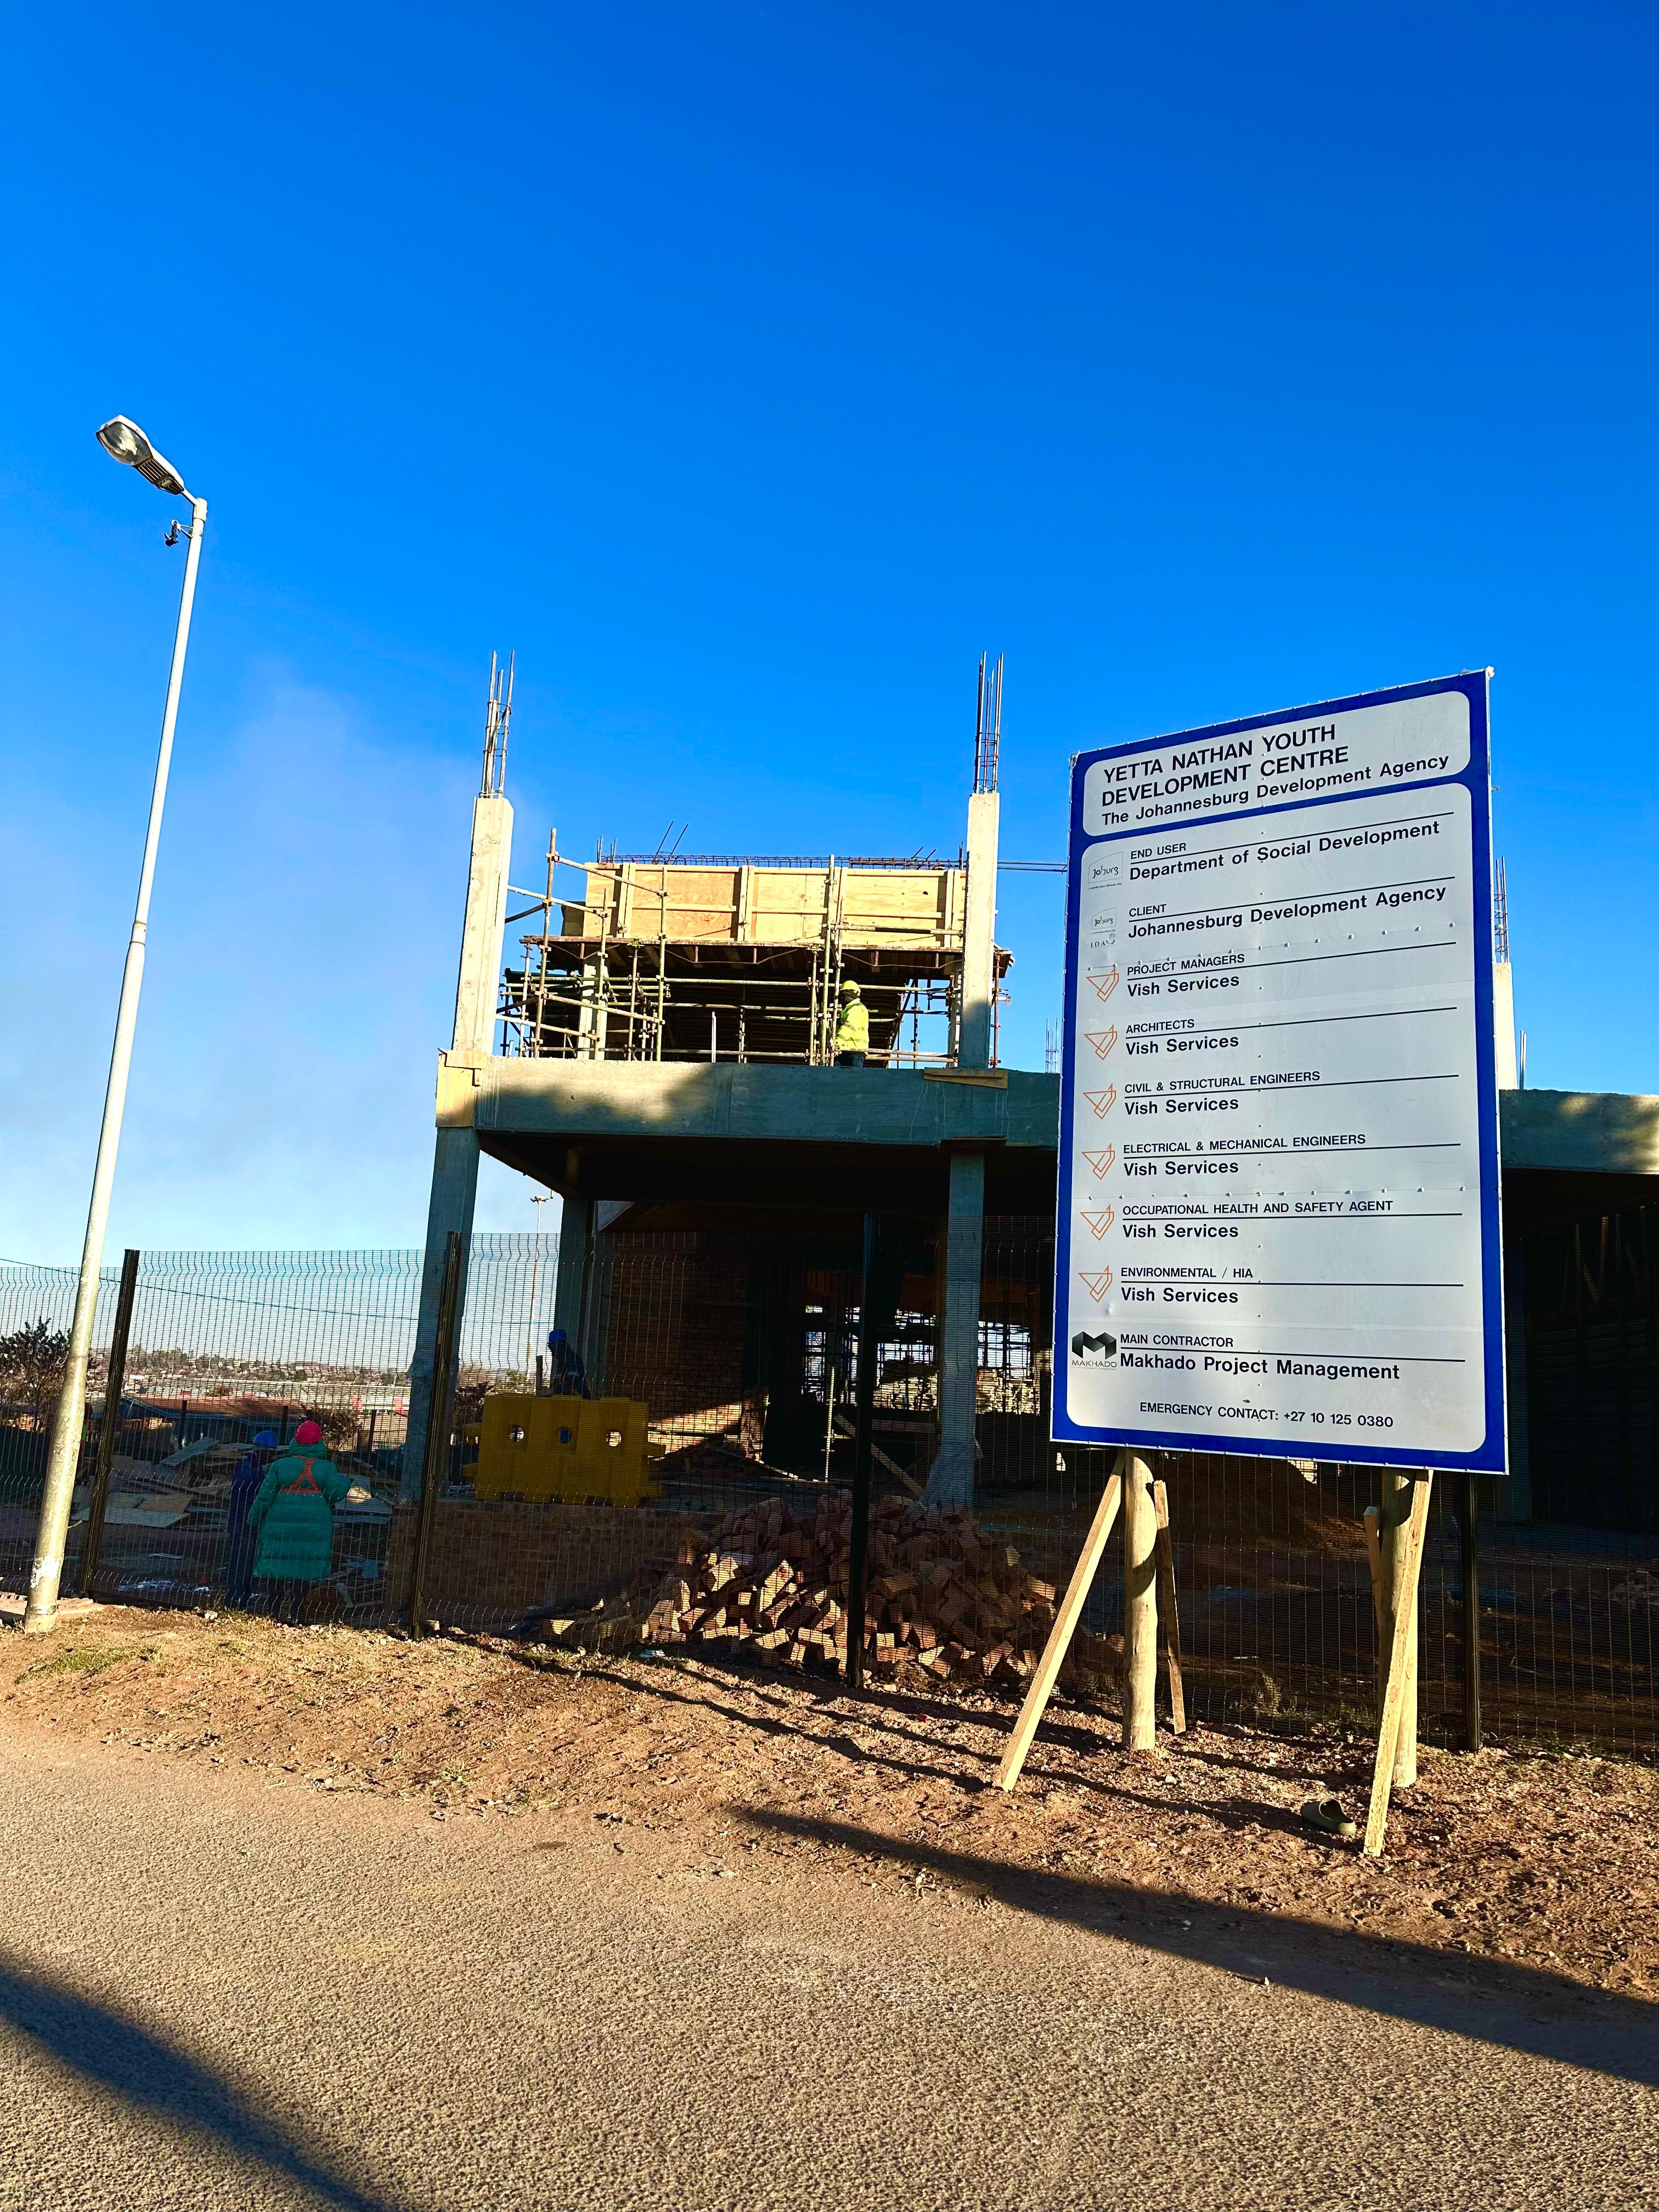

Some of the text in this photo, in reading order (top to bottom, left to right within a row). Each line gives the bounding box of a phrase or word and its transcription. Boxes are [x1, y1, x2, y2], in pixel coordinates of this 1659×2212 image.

[1103, 724, 1336, 783] YETTA NATHAN YOUTH
[1102, 746, 1349, 806] DEVELOPMENT CENTRE
[1102, 755, 1449, 826] The Johannesburg Development Agency
[1130, 842, 1187, 860] END USER
[1130, 821, 1440, 881] Department of Social Development
[1092, 865, 1119, 879] Joburg
[1128, 904, 1167, 917] CLIENT
[1128, 887, 1446, 939] Johannesburg Development Agency
[1127, 953, 1245, 976] PROJECT MANAGERS
[1127, 976, 1239, 997] Vish Services
[1126, 1019, 1195, 1034] ARCHITECTS
[1125, 1036, 1239, 1055] Vish Services
[1125, 1071, 1321, 1093] CIVIL & STRUCTURAL ENGINEERS
[1124, 1097, 1239, 1115] Vish Services
[1124, 1134, 1366, 1154] ELECTRICAL & MECHANICAL ENGINEERS
[1124, 1160, 1239, 1176] Vish Services
[1122, 1200, 1393, 1215] OCCUPATIONAL HEALTH AND SAFETY AGENT
[1122, 1223, 1239, 1238] Vish Services
[1121, 1267, 1253, 1279] ENVIRONMENTAL / HIA
[1121, 1287, 1238, 1304] Vish Services
[1120, 1334, 1233, 1347] MAIN CONTRACTOR
[1071, 1359, 1117, 1368] MAKHADO
[1120, 1352, 1400, 1380] Makhado Project Management
[1140, 1402, 1393, 1427] EMERGENCY CONTACT: +27 10 125 0380
